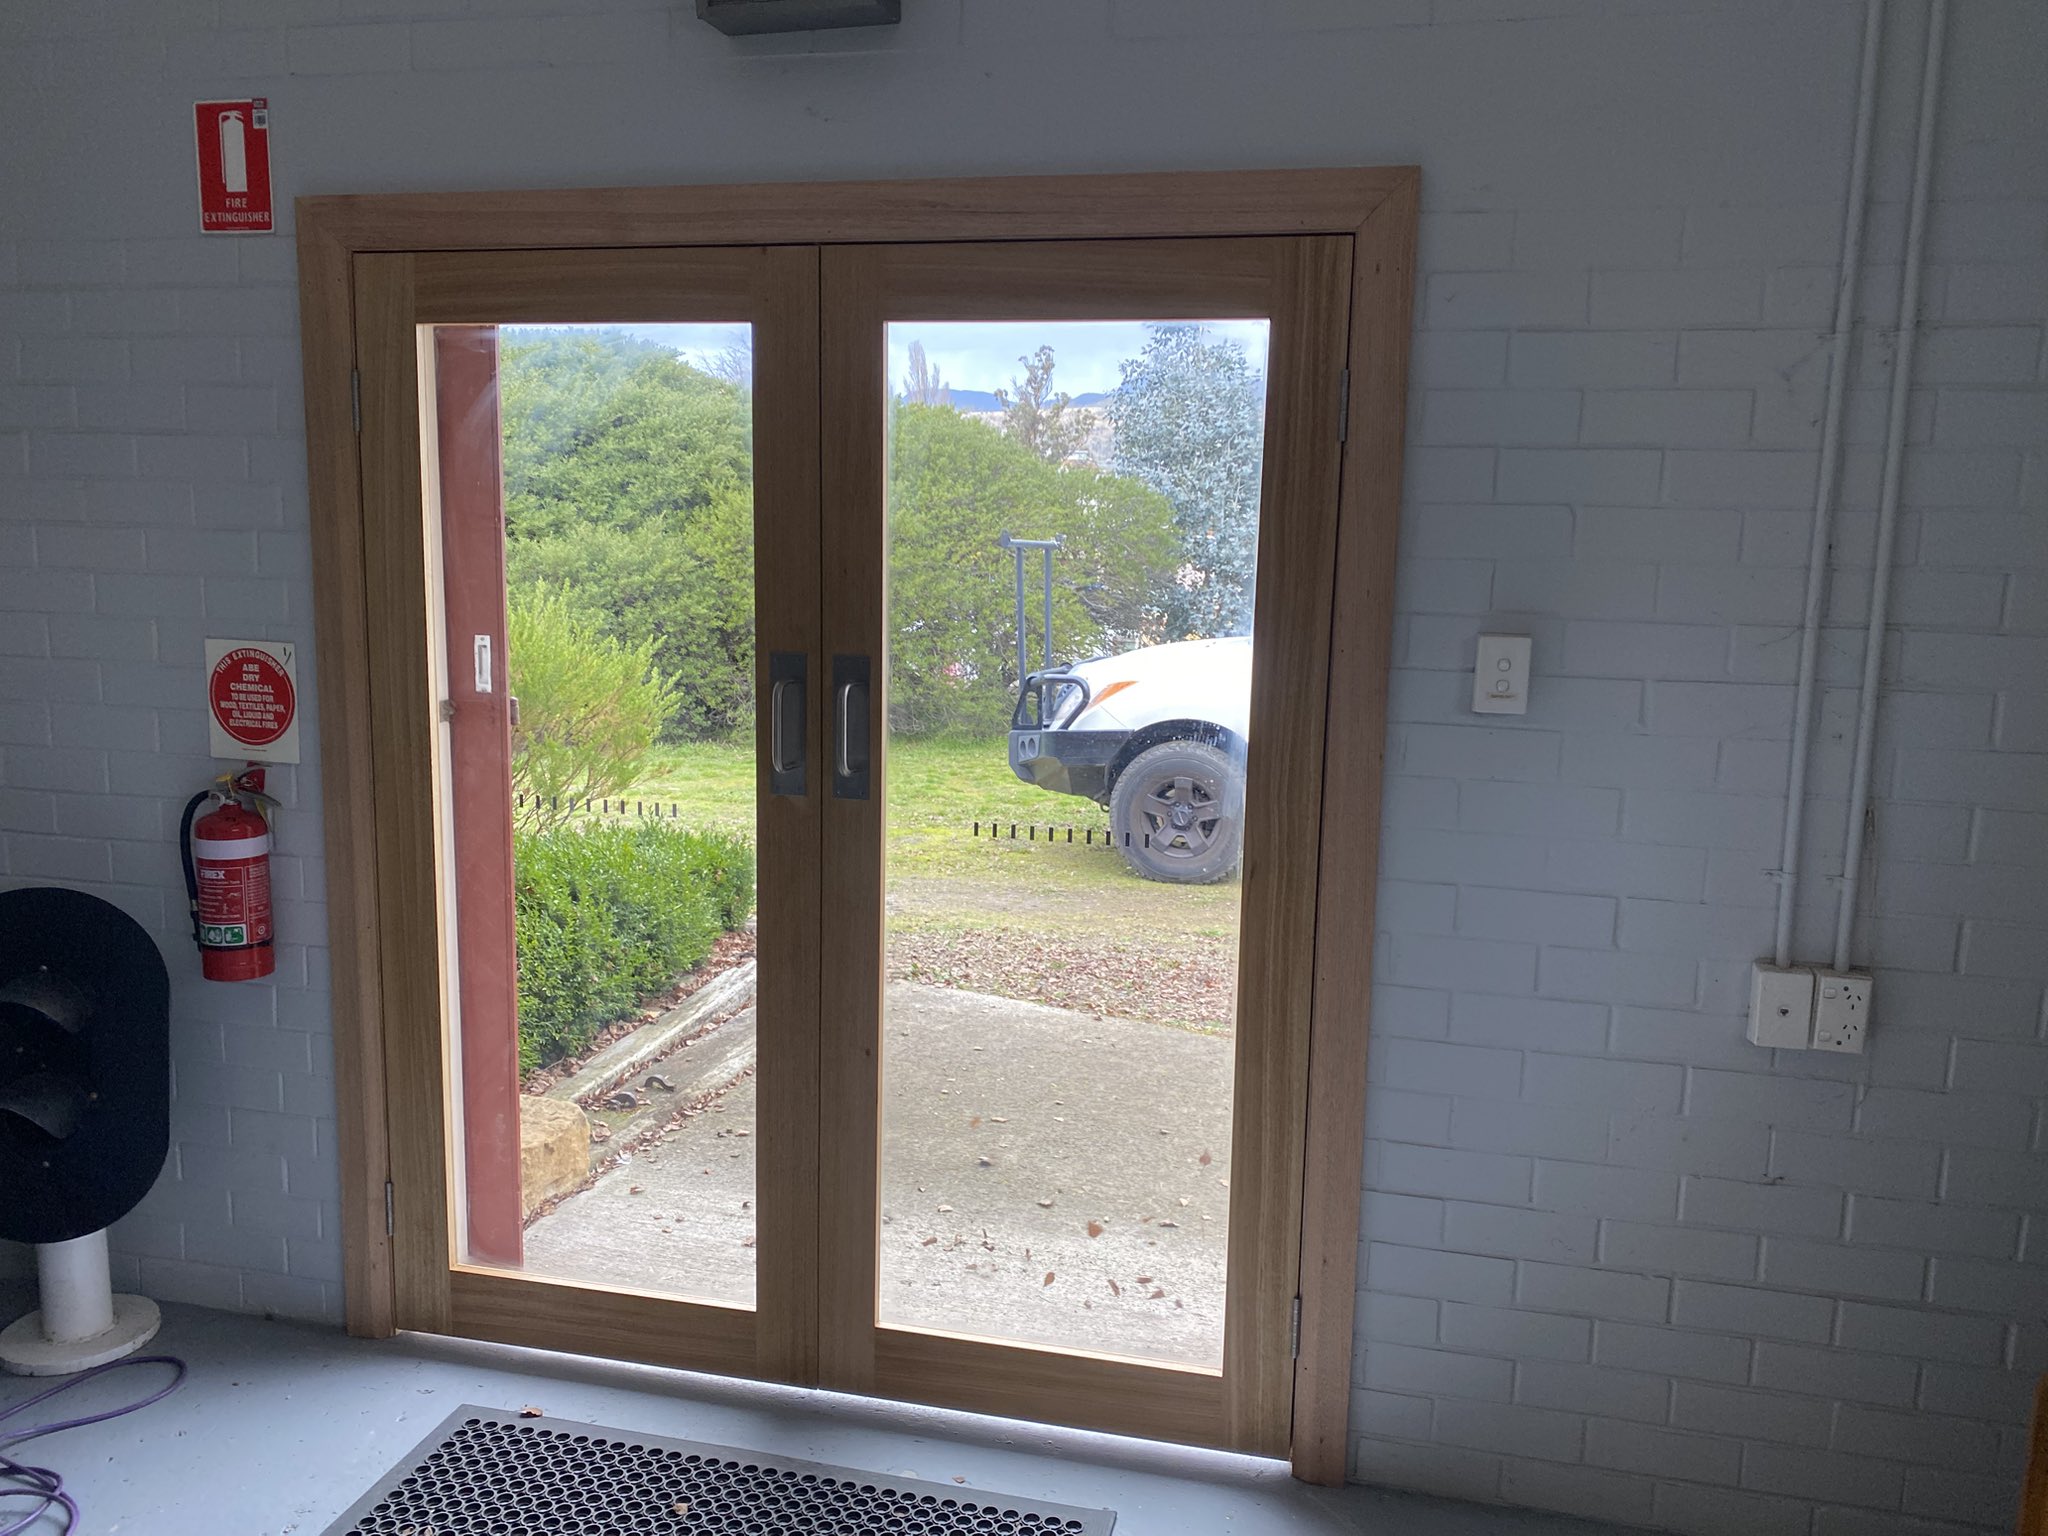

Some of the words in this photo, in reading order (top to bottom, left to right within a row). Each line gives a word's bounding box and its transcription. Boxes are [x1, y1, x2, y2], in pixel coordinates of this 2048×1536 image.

[226, 198, 247, 208] FIRE
[204, 212, 270, 222] EXTINGUISHER
[216, 658, 231, 673] THIS
[233, 650, 284, 677] EXTINGUISHER
[242, 664, 259, 672] ABE
[230, 682, 274, 692] CHEMICAL
[266, 704, 286, 713] PAPER,
[262, 712, 274, 720] AND
[229, 719, 262, 727] ELECTRICAL
[262, 721, 278, 729] FIRES
